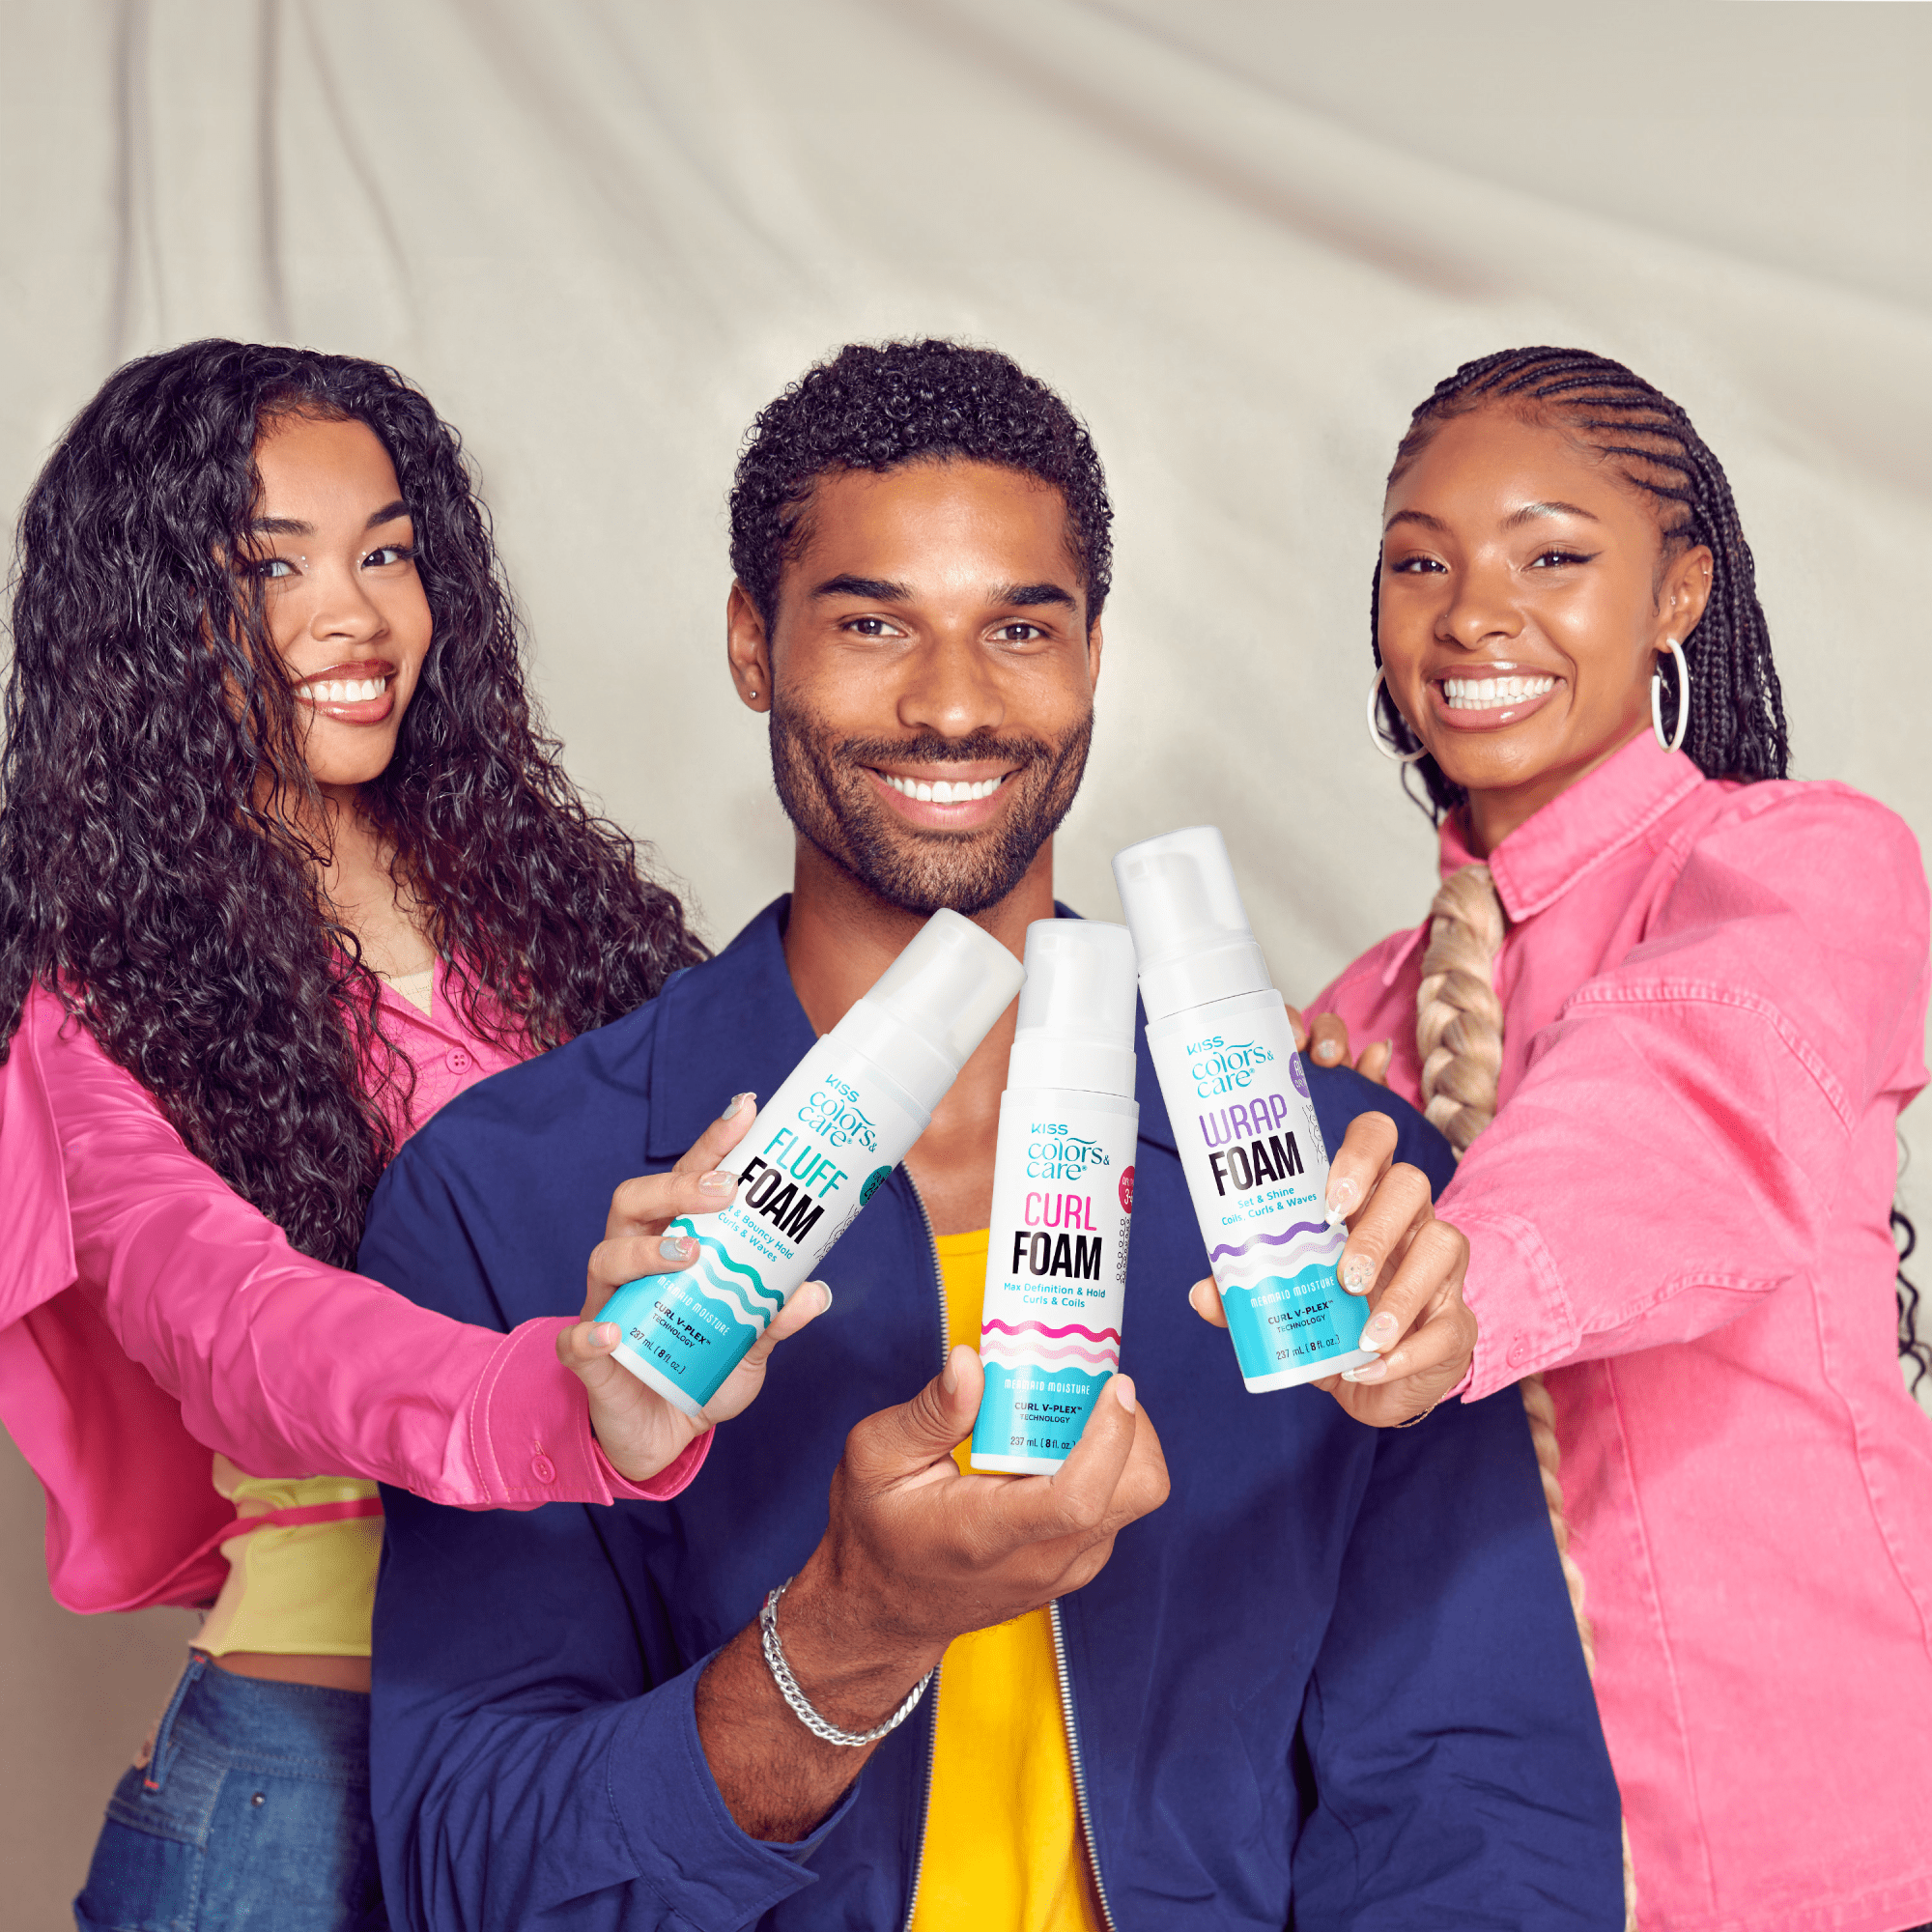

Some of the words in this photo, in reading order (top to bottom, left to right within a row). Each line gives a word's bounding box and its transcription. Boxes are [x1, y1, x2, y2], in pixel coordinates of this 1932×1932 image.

[1186, 1036, 1224, 1056] KISS
[825, 1073, 860, 1103] KISS
[1031, 1122, 1068, 1135] KISS
[1199, 1094, 1288, 1149] WRAP
[763, 1127, 848, 1198] FLUFF
[1208, 1131, 1305, 1197] FOAM
[738, 1156, 825, 1245] FOAM
[1237, 1197, 1254, 1209] Set
[1257, 1194, 1264, 1204] &
[1266, 1187, 1294, 1203] Shine
[1024, 1191, 1097, 1232] CURL
[1221, 1212, 1246, 1226] Coils,
[1248, 1205, 1274, 1219] Curls
[1277, 1201, 1285, 1210] &
[1287, 1193, 1318, 1208] Waves
[718, 1211, 740, 1233] Curls
[740, 1229, 748, 1238] &
[749, 1235, 778, 1263] Waves
[733, 1209, 741, 1218] &
[742, 1214, 775, 1244] Bouncy
[774, 1240, 795, 1260] Hold
[1012, 1230, 1103, 1281] FOAM
[1004, 1282, 1021, 1293] Max
[1024, 1283, 1073, 1295] Definition
[1076, 1286, 1084, 1296] &
[1086, 1288, 1106, 1298] Hold
[1023, 1294, 1048, 1305] Curls
[1051, 1296, 1059, 1306] &
[1061, 1297, 1086, 1308] Coils
[1250, 1289, 1291, 1309] MERMAID
[1293, 1276, 1335, 1297] MOISTURE
[654, 1300, 674, 1321] CURL
[657, 1275, 694, 1306] MERMAID
[692, 1302, 730, 1336] MOISTURE
[1267, 1312, 1293, 1325] CURL
[1276, 1314, 1326, 1333] TECHNOLOGY
[630, 1326, 645, 1342] 237
[652, 1313, 696, 1349] TECHNOLOGY
[1276, 1349, 1291, 1361] 237
[1005, 1378, 1045, 1392] MERMAID
[1047, 1381, 1091, 1395] MOISTURE
[1014, 1402, 1039, 1411] CURL
[1020, 1413, 1070, 1424] TECHNOLOGY
[1010, 1435, 1025, 1446] 237
